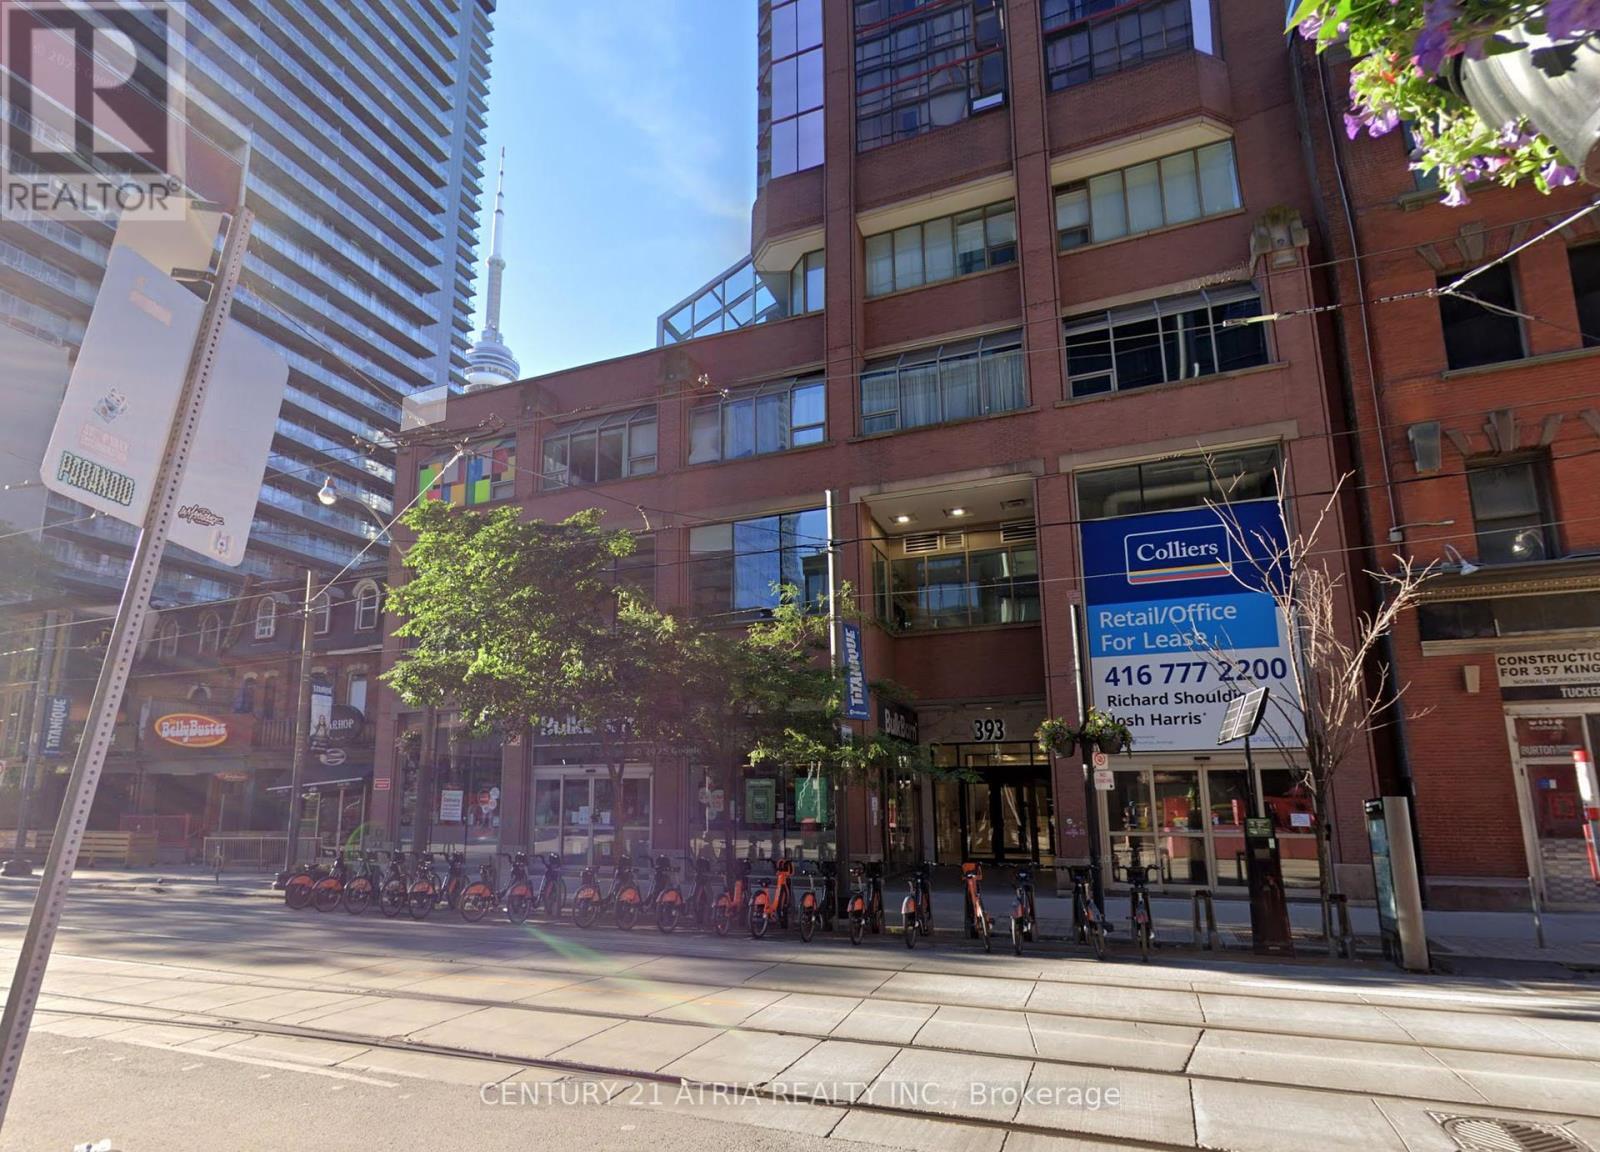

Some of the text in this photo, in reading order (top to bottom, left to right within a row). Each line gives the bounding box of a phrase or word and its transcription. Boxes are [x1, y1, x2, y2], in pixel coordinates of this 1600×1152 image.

[57, 450, 136, 506] PARANOID
[1136, 540, 1219, 562] Colliers
[1099, 603, 1238, 628] Retail/Office
[1101, 630, 1208, 652] For Lease
[1104, 657, 1288, 687] 416 777 2200
[1500, 663, 1600, 676] FOR 357 KING
[1107, 691, 1169, 707] Richard
[974, 719, 1004, 741] 393
